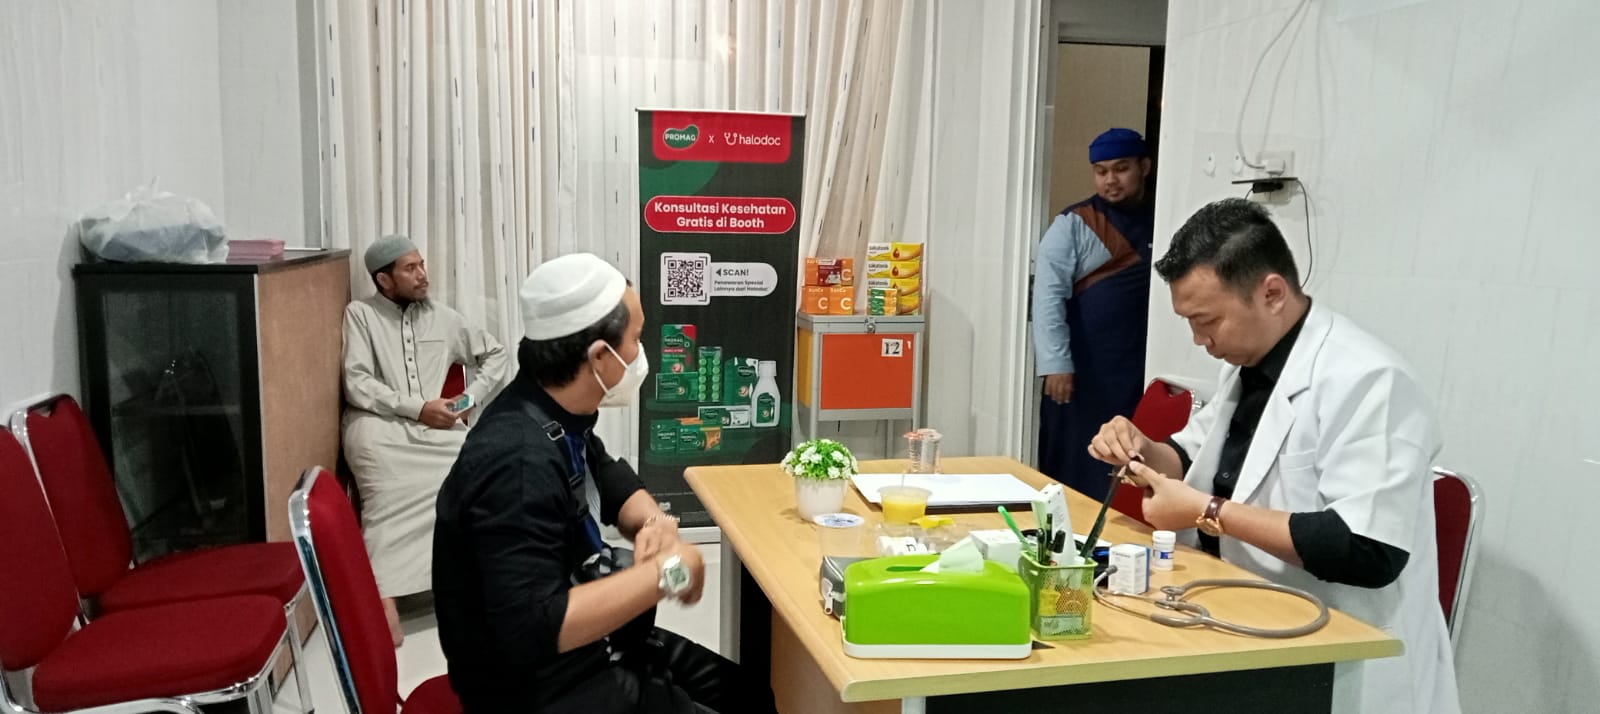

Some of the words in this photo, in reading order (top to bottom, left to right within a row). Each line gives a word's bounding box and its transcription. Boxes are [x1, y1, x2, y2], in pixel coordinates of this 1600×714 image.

[664, 133, 696, 142] PROMAG
[739, 134, 781, 146] halodoc
[654, 202, 719, 214] Konsultasi
[721, 202, 786, 215] Kesehatan
[676, 216, 714, 227] Gratis
[715, 216, 727, 228] di
[729, 217, 765, 228] Booth
[722, 268, 749, 277] SCAN!
[817, 297, 828, 310] C
[840, 297, 852, 310] C
[884, 341, 900, 354] 12
